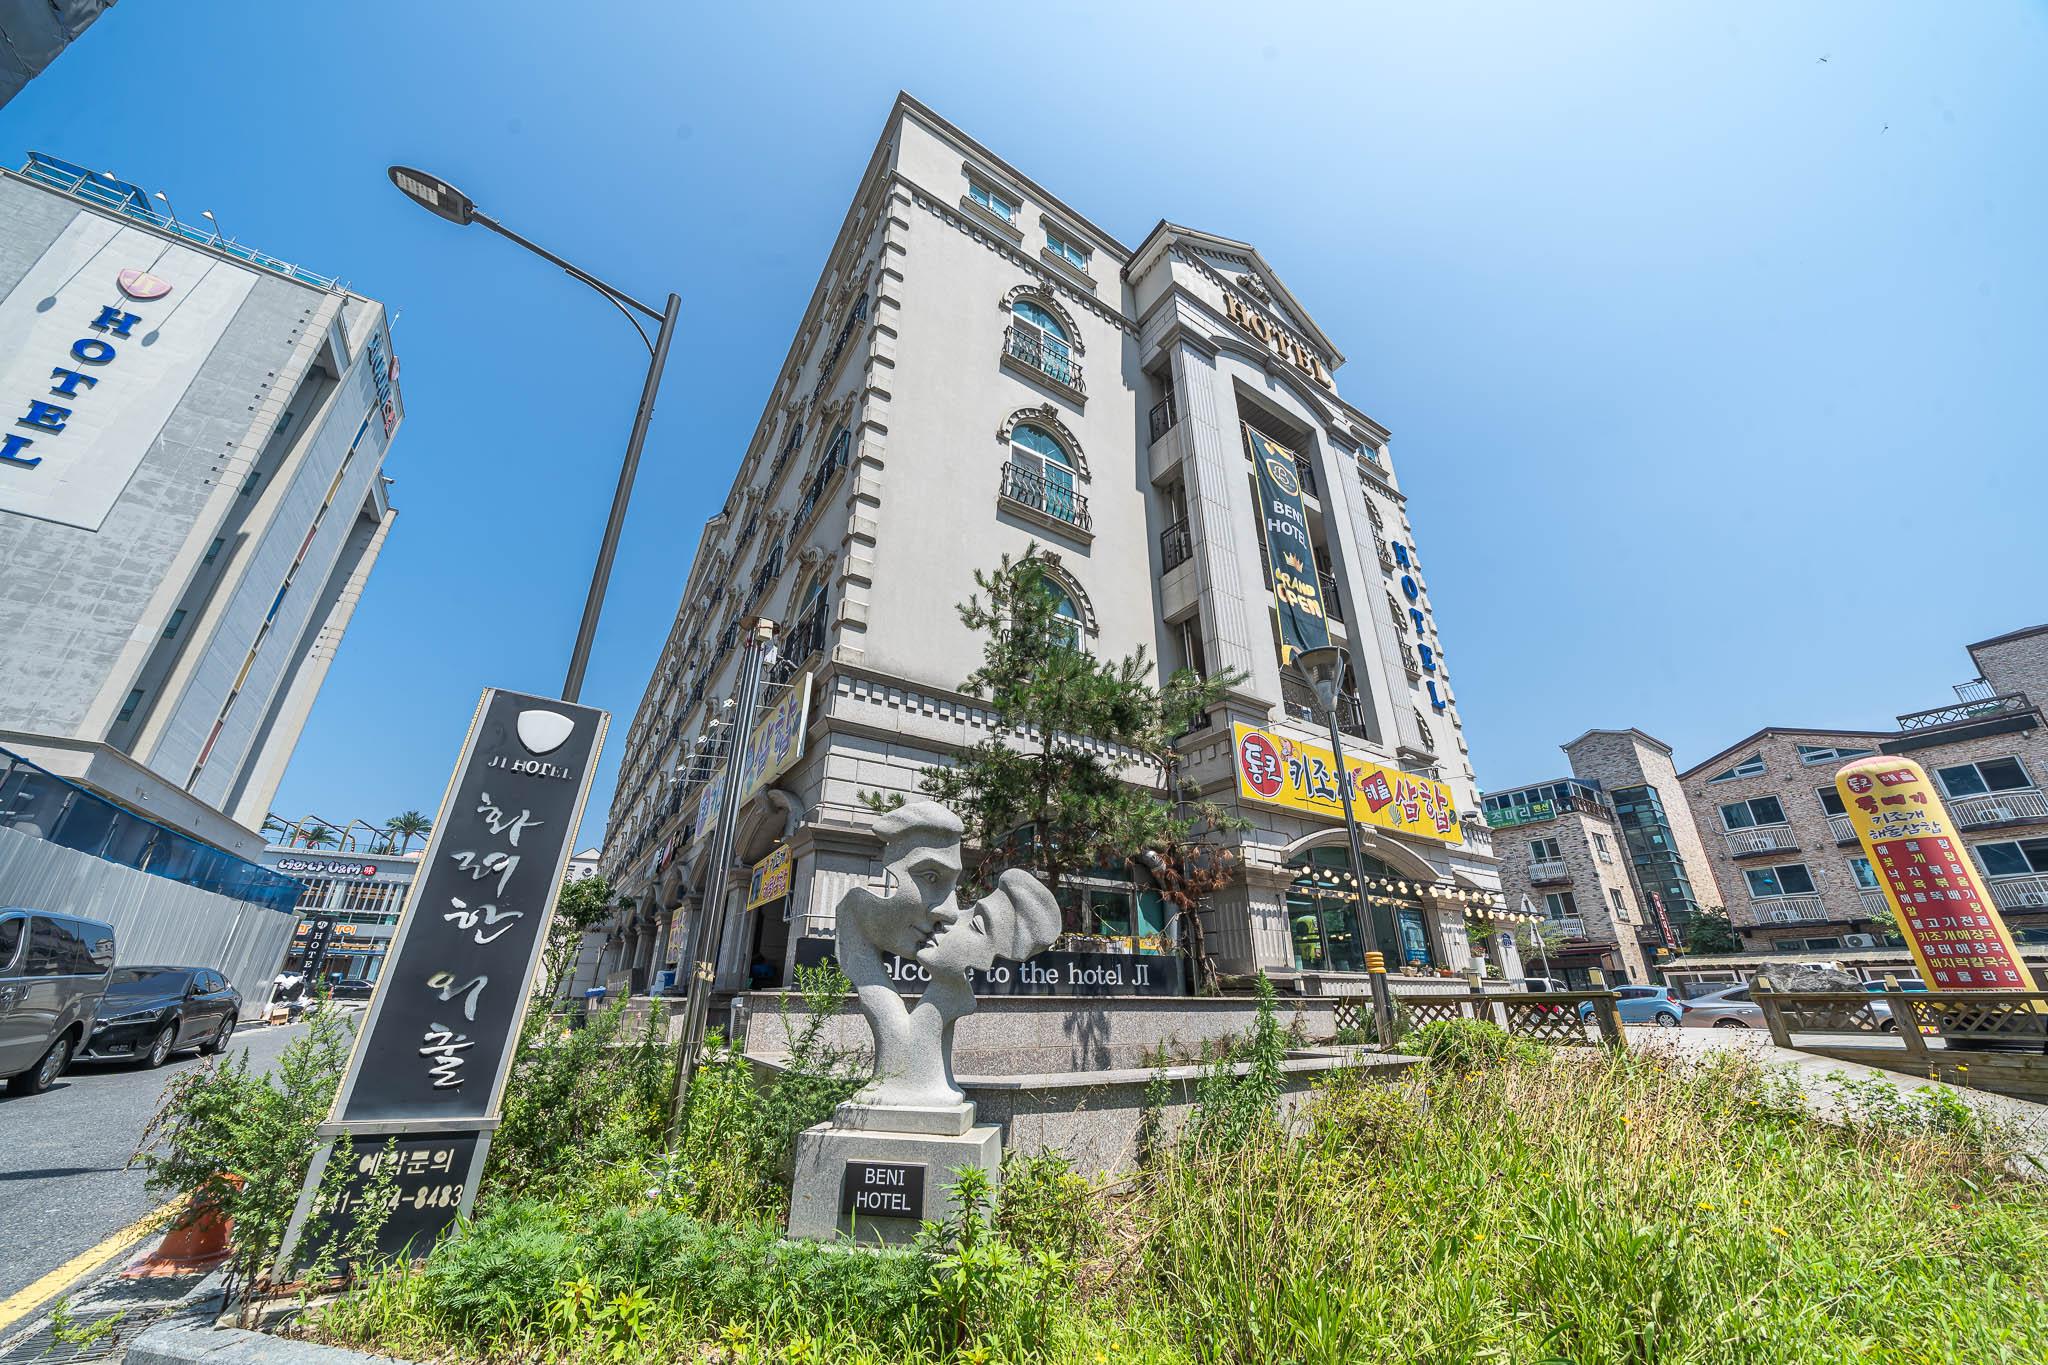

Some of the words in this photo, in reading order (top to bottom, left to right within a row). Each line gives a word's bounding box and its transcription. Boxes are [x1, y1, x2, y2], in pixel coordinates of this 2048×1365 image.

[1223, 293, 1332, 389] HOTEL
[0, 304, 143, 468] HOTEL
[1273, 500, 1304, 528] BENI
[1267, 518, 1308, 550] HOTEL
[1277, 583, 1323, 618] OPEN
[1391, 540, 1447, 710] HOTEL
[488, 756, 508, 769] JI
[1243, 741, 1283, 784] 통큰
[1395, 777, 1451, 834] 삼합
[302, 932, 323, 979] HOTEL
[884, 956, 975, 983] elcoe
[986, 967, 1010, 985] to
[1019, 961, 1059, 985] the
[1068, 963, 1124, 986] hotel
[1131, 964, 1151, 987] JI
[865, 1167, 906, 1186] BENI
[856, 1191, 912, 1211] HOTEL
